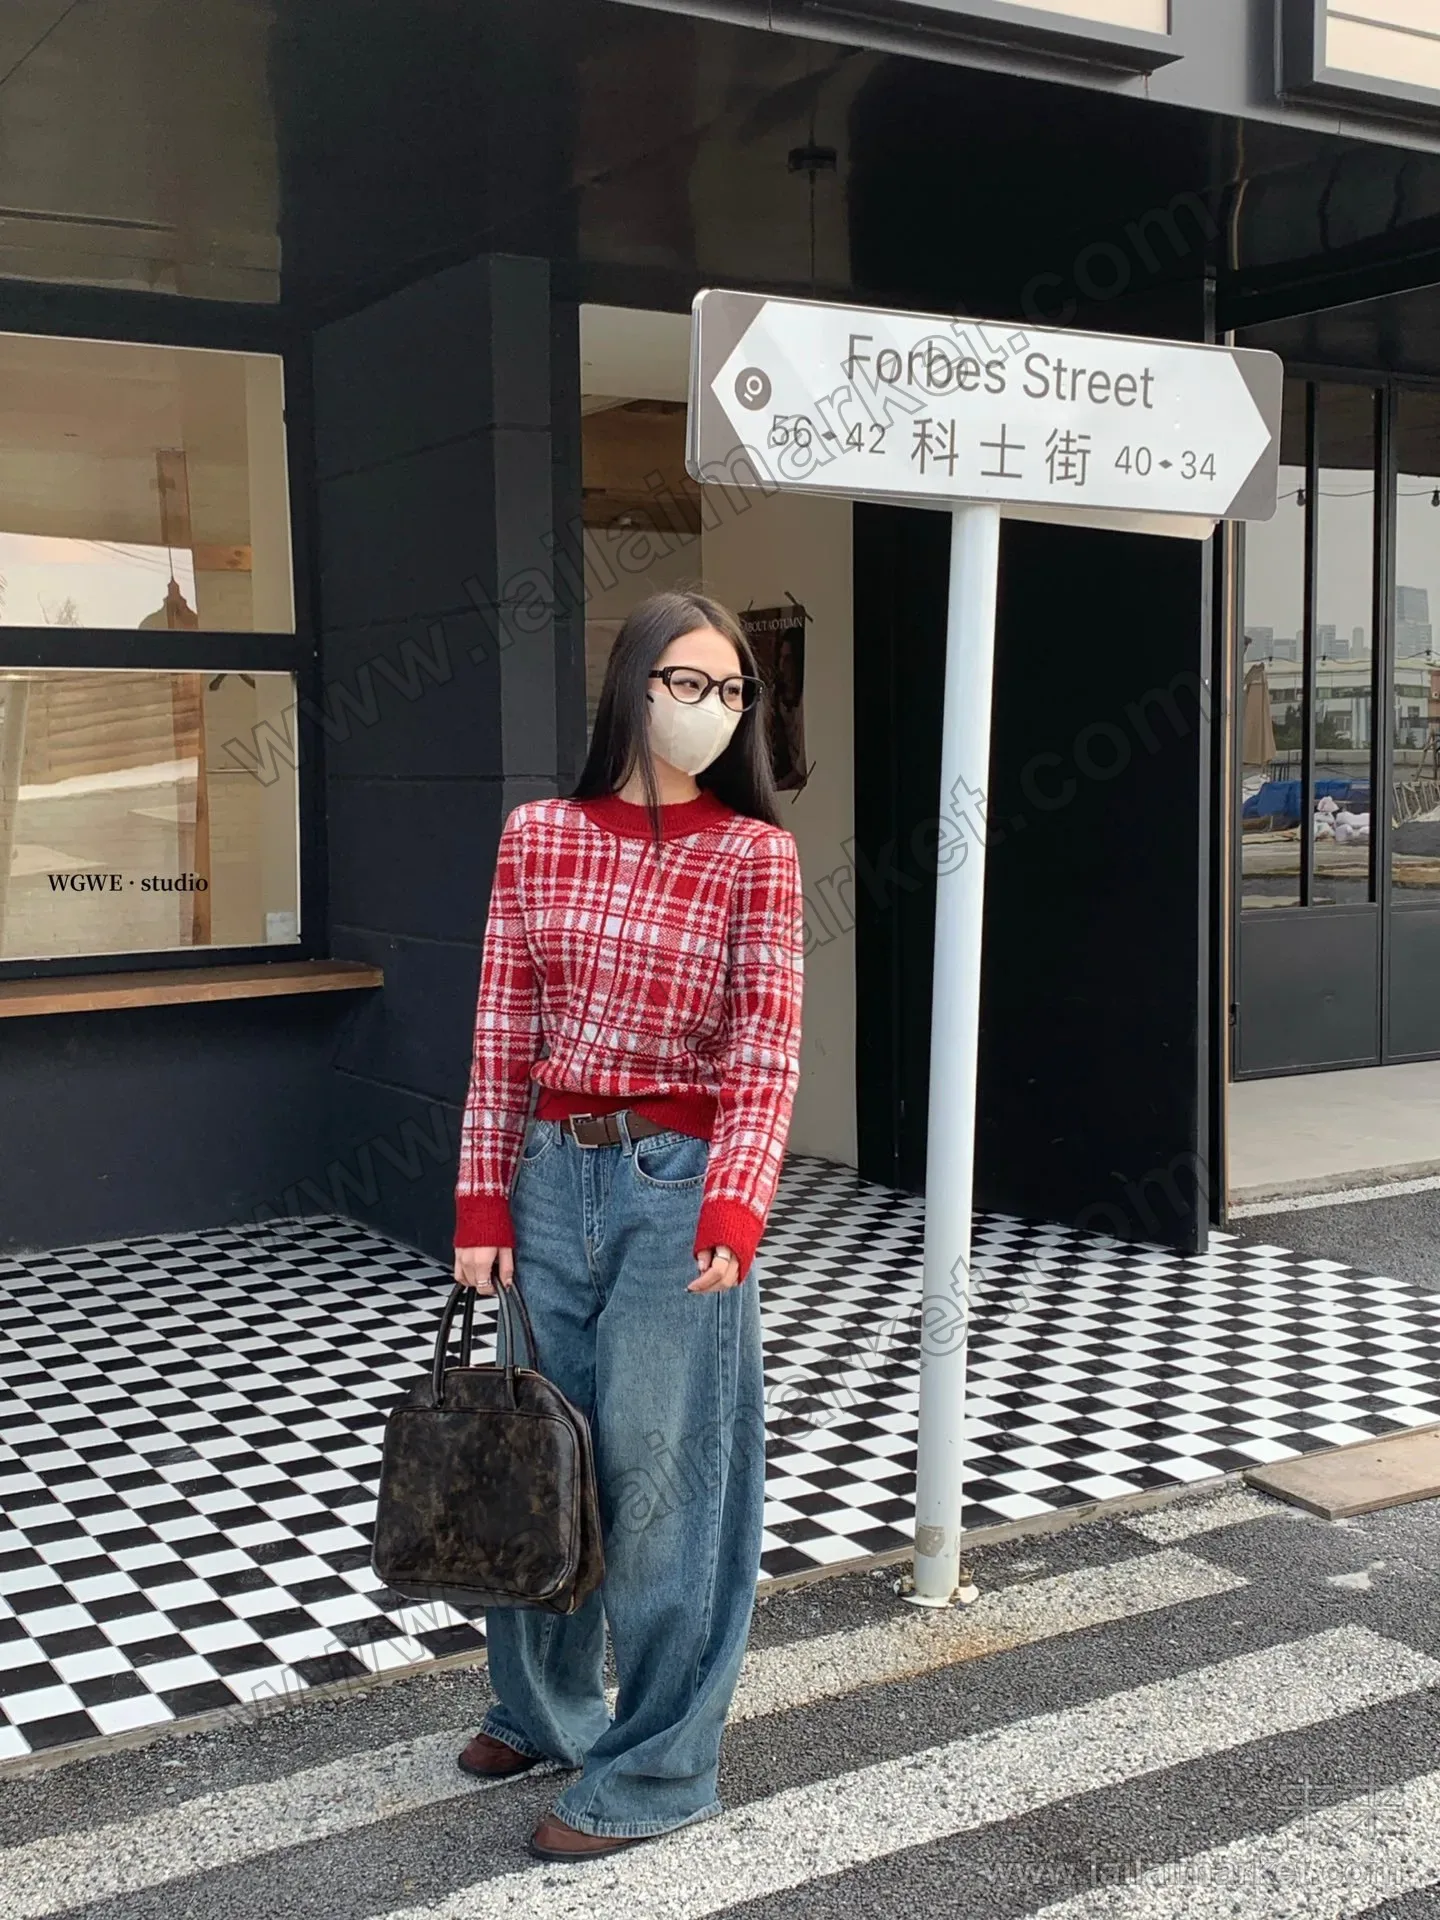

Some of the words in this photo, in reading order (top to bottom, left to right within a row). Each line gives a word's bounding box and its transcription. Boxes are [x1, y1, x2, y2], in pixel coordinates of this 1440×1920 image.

[848, 333, 1006, 395] Forbes
[1022, 352, 1155, 409] Street
[772, 414, 812, 448] 56
[845, 422, 886, 454] 42
[911, 418, 1092, 487] 科士街
[1114, 445, 1152, 476] 40
[1180, 450, 1217, 481] 34
[47, 874, 123, 892] WGWE
[141, 872, 208, 892] studio
